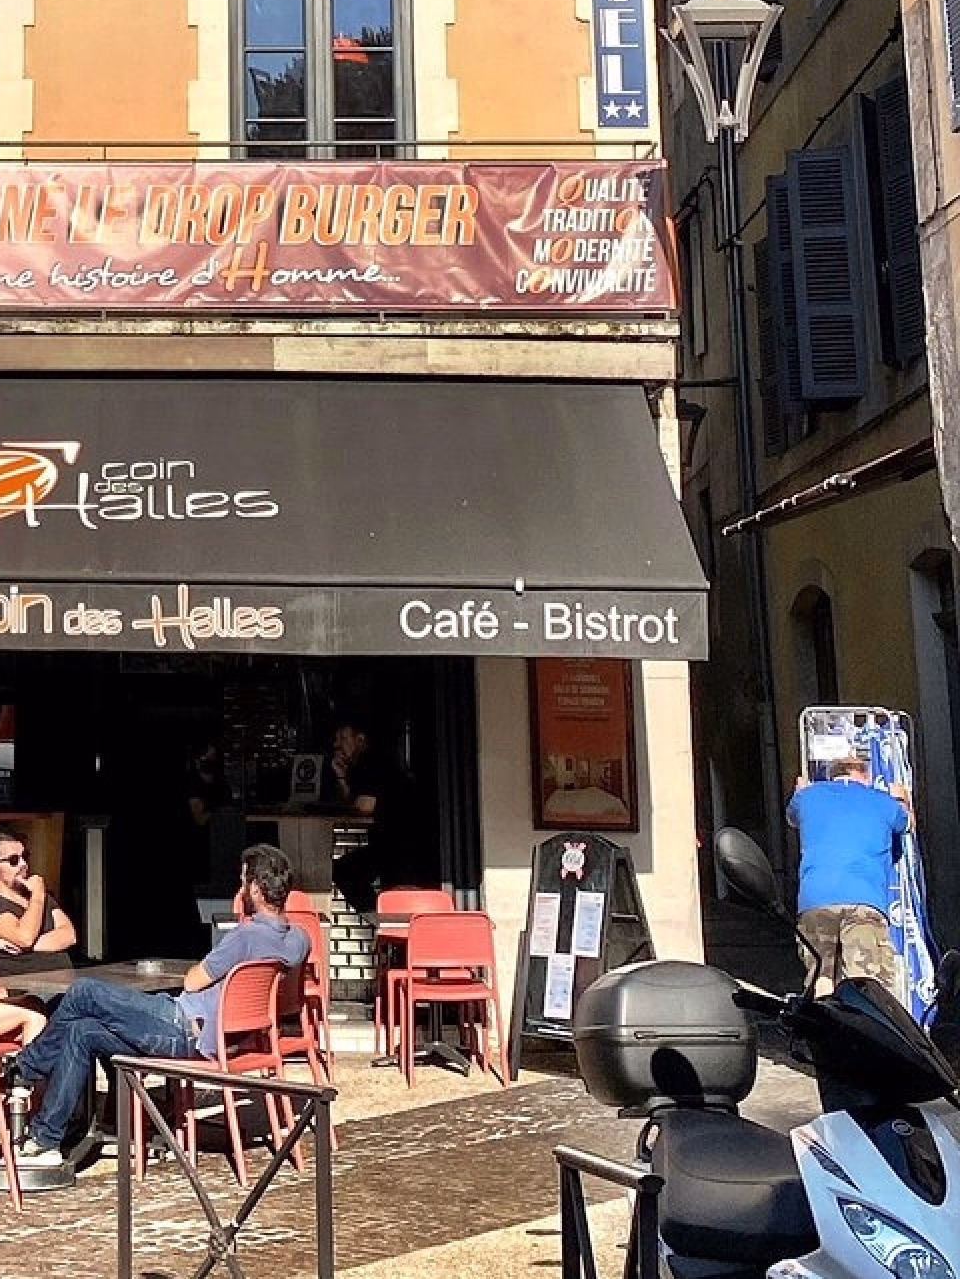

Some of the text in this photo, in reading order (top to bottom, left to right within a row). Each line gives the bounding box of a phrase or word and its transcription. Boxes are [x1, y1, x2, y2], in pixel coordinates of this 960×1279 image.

[558, 172, 651, 206] QUALITÉ
[69, 184, 135, 244] LE
[139, 184, 277, 246] DROP
[280, 184, 480, 247] BURGER
[543, 206, 653, 234] TRADITION
[534, 234, 657, 264] MODERNITÉ
[49, 256, 178, 291] histoire
[515, 262, 657, 294] CONVIVIALITÉ
[101, 457, 195, 480] coin
[93, 478, 144, 494] des
[63, 602, 123, 636] des
[131, 583, 284, 650] Halles
[399, 600, 500, 641] Café
[543, 602, 680, 644] Bistrot
